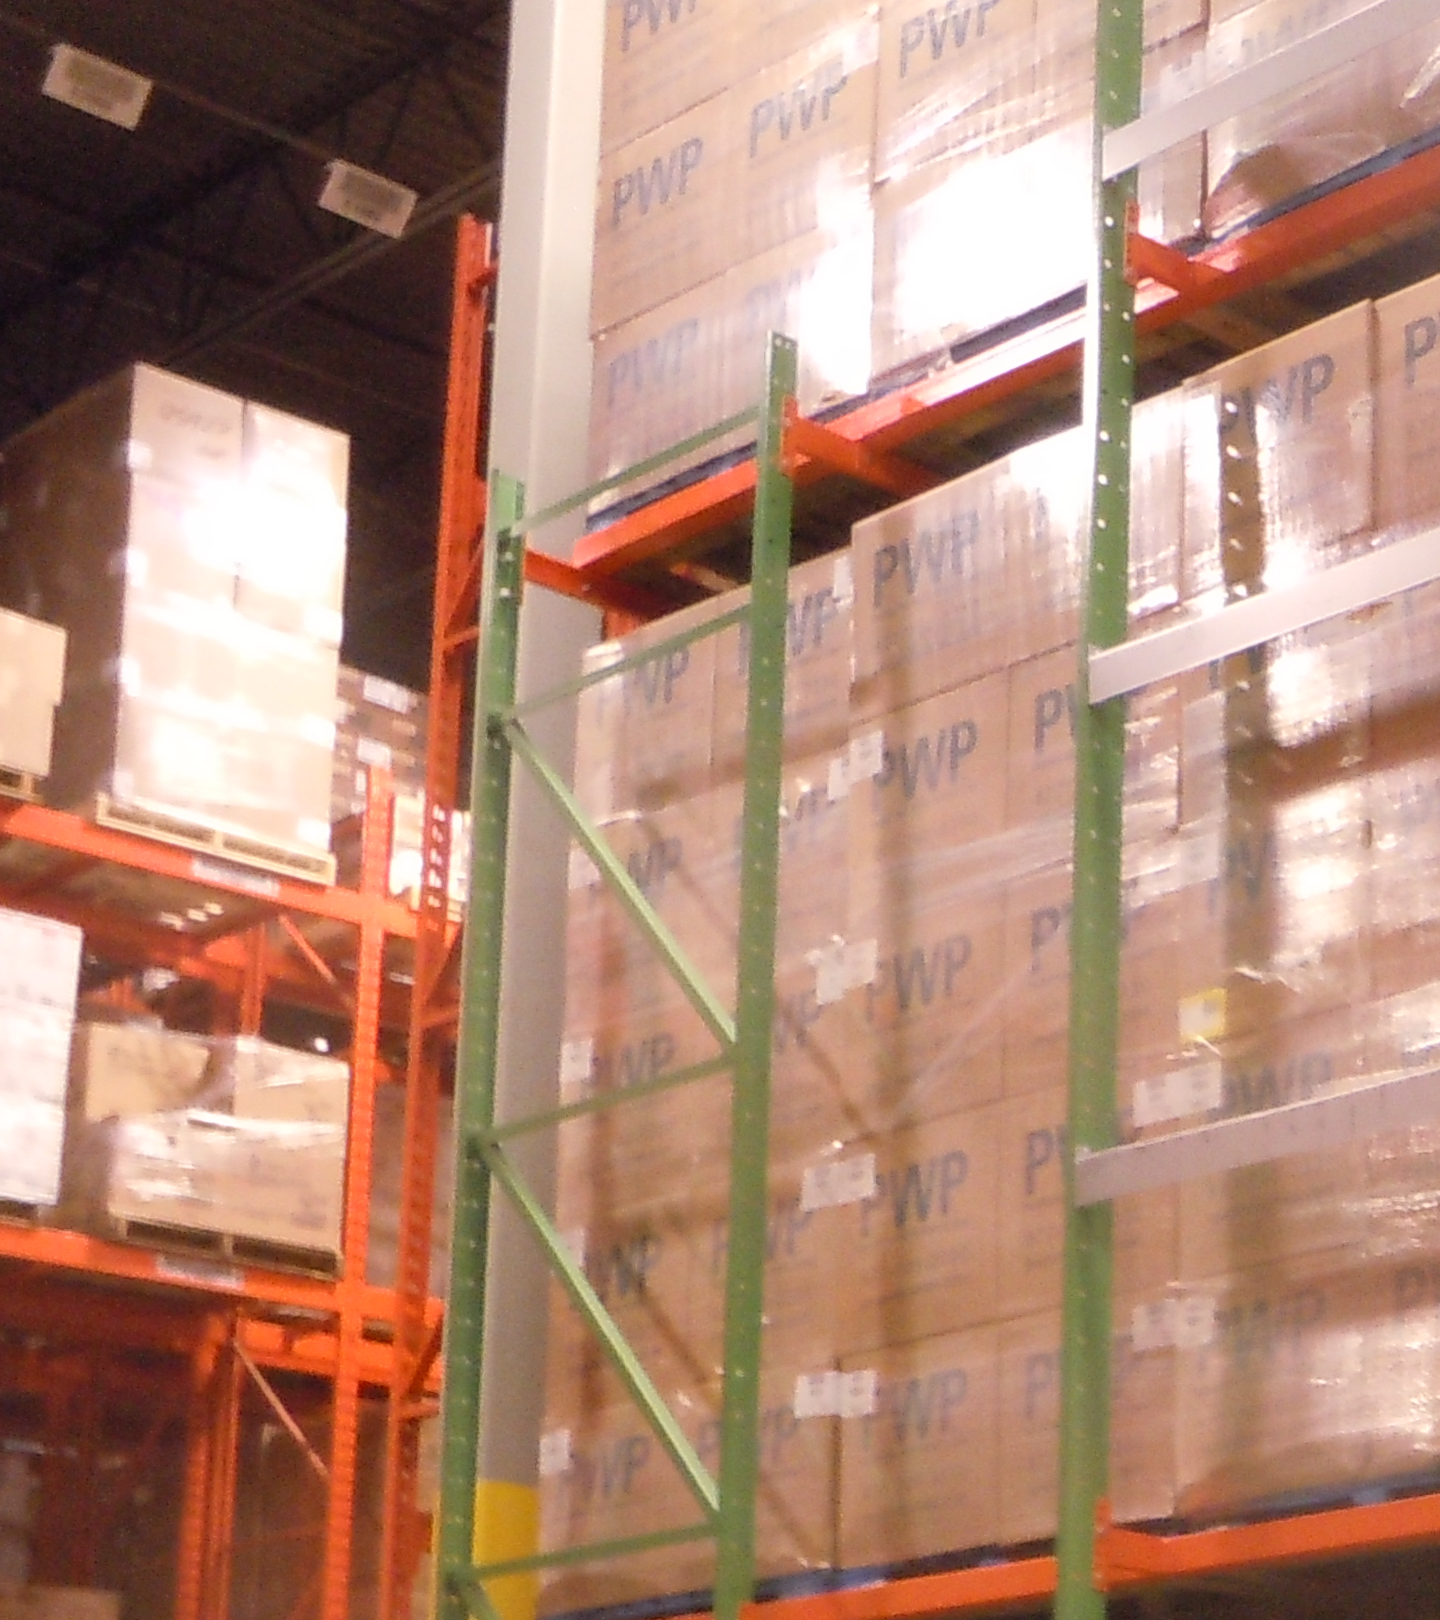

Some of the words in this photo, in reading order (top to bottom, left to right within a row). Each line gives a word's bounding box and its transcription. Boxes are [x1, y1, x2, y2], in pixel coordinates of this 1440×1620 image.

[622, 0, 700, 51] PW
[750, 59, 848, 158] PWP
[612, 138, 704, 229] PWP
[873, 509, 981, 605] PWP
[874, 719, 980, 801] PWP
[859, 1150, 969, 1234] PWP
